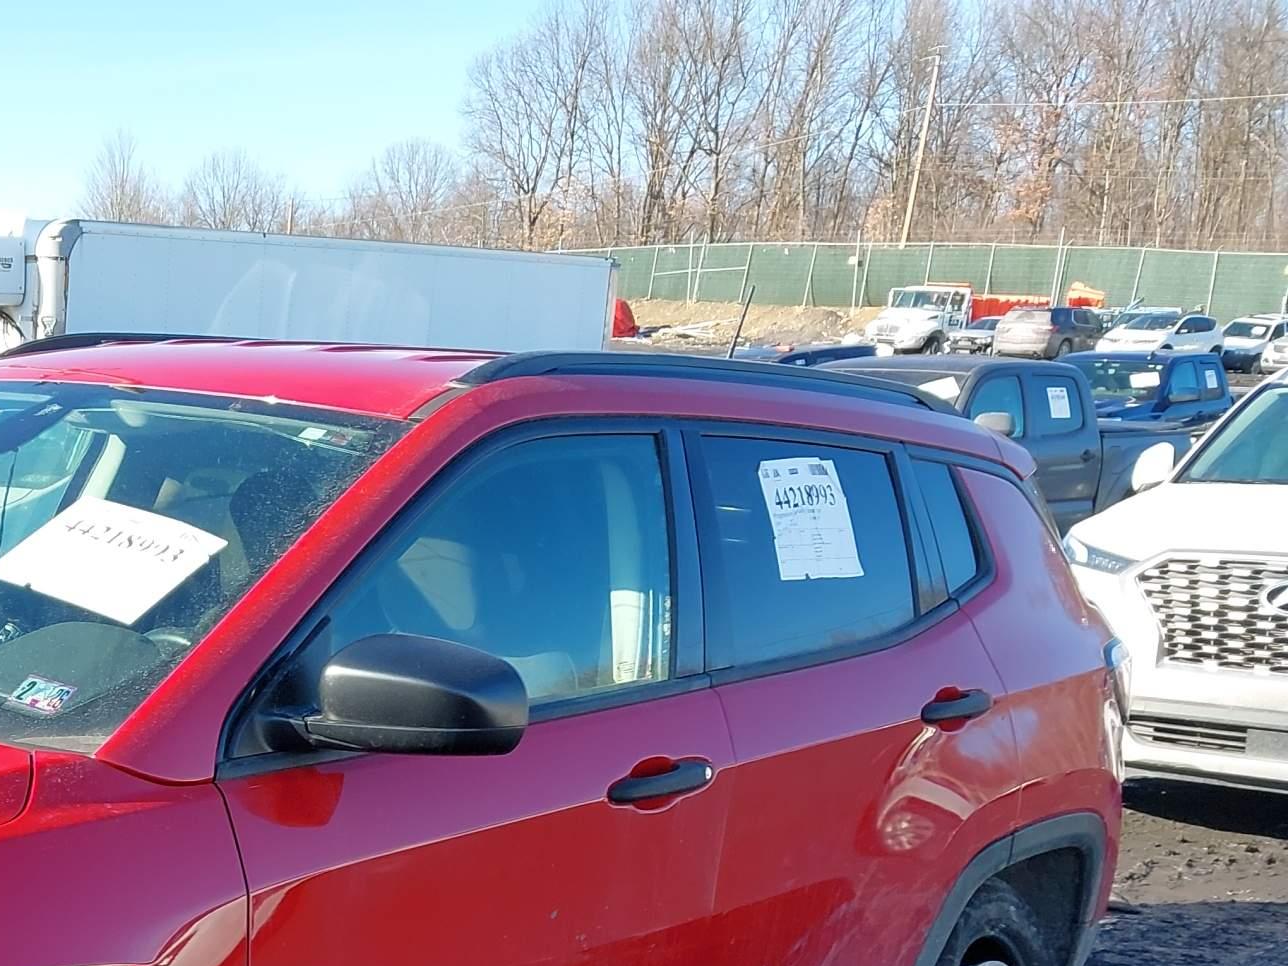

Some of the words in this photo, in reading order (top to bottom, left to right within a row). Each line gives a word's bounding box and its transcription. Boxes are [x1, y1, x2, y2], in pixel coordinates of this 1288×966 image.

[774, 483, 837, 511] 44218993
[64, 519, 186, 564] 44218993
[14, 680, 38, 701] 2
